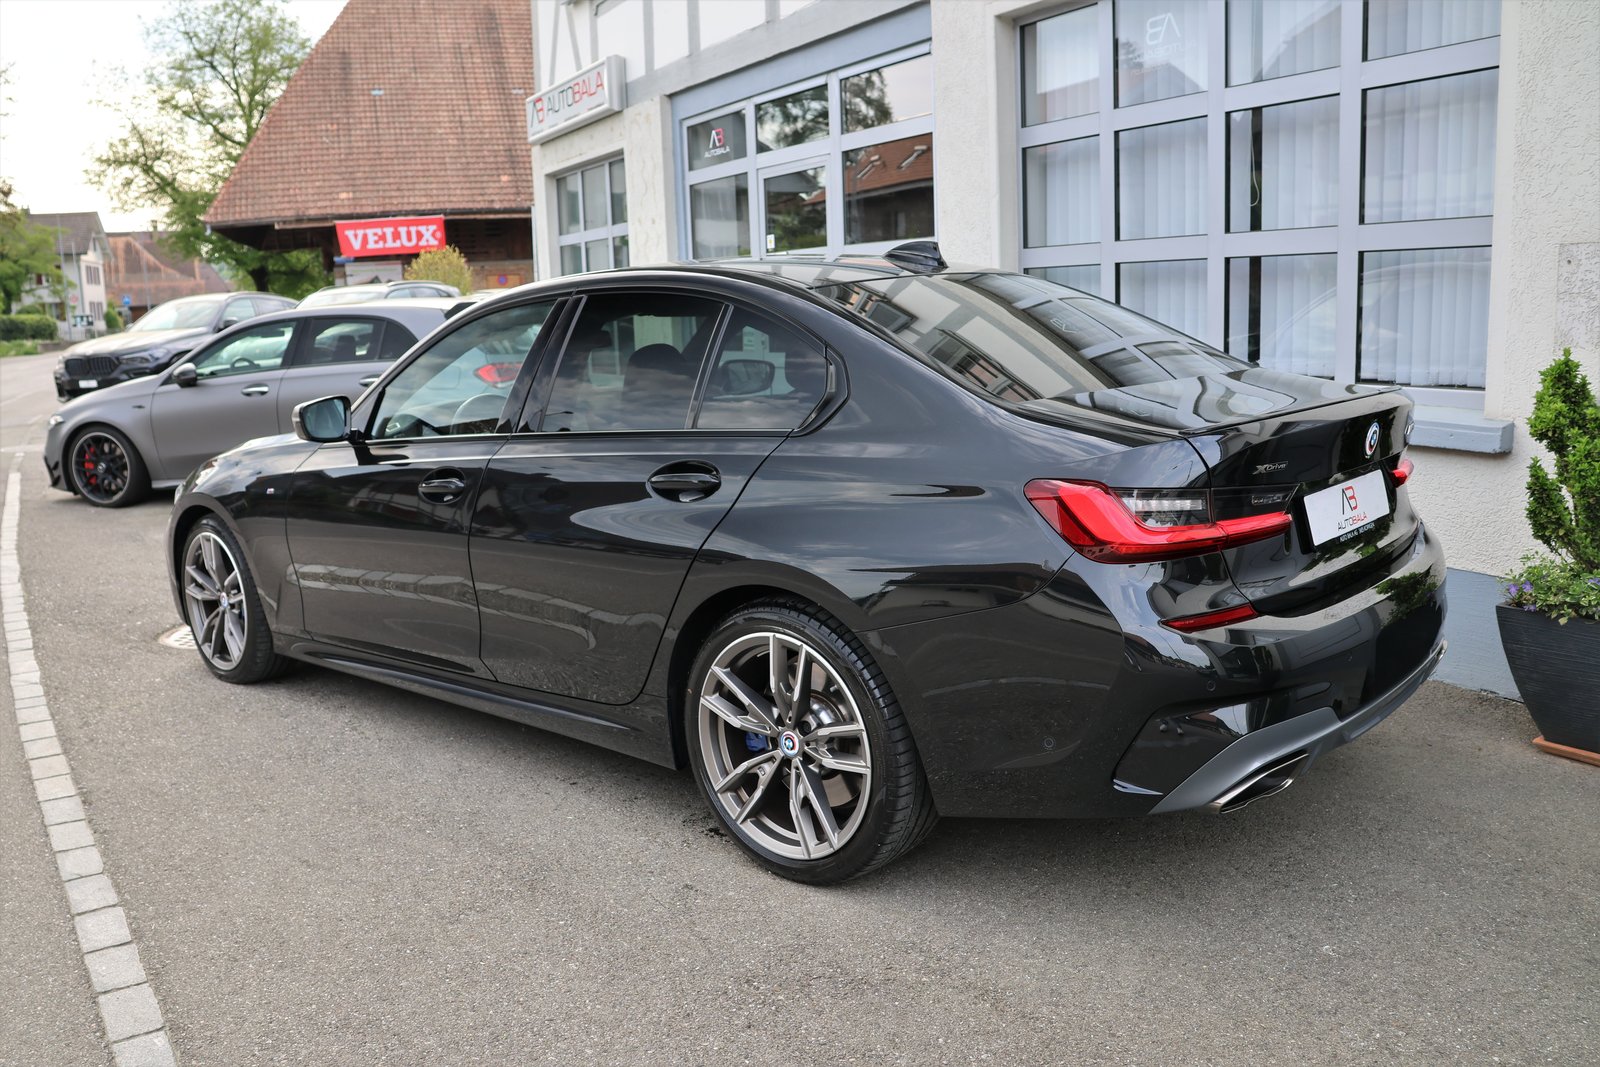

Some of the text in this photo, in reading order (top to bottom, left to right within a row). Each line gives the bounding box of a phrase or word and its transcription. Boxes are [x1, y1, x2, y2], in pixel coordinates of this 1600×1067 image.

[546, 70, 604, 116] AUTOBALA
[344, 224, 439, 250] VELUX
[1337, 511, 1368, 531] AUTOBALA
